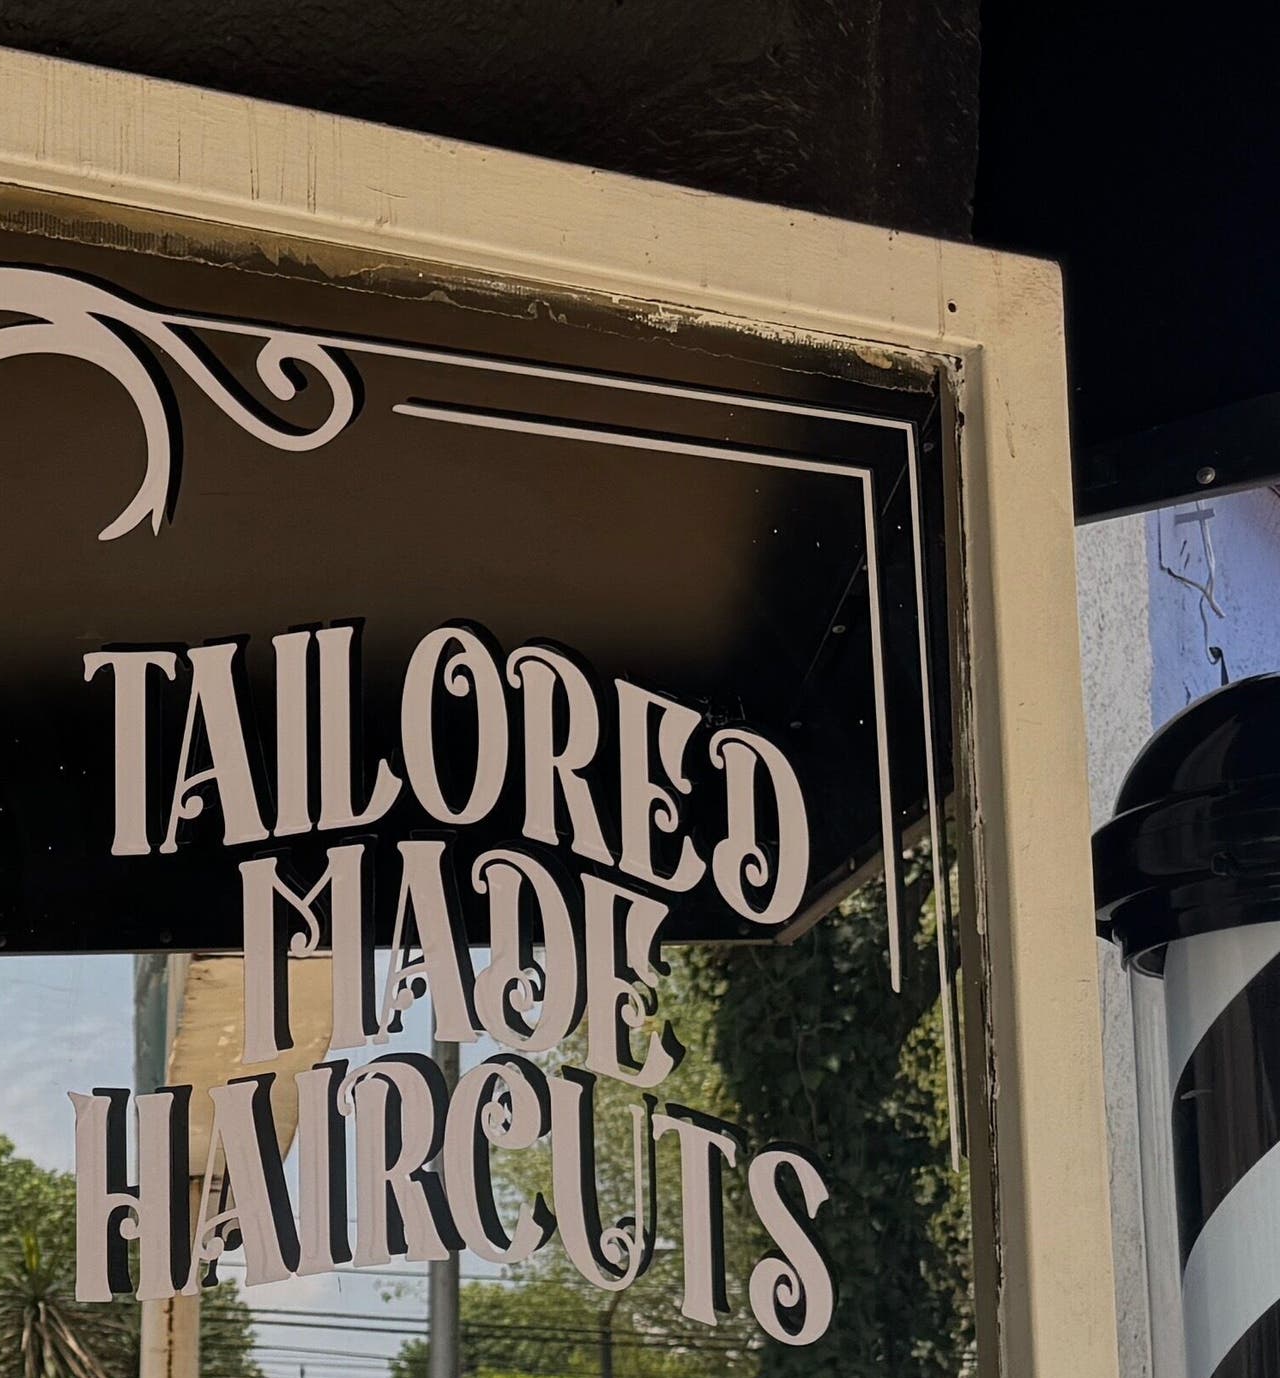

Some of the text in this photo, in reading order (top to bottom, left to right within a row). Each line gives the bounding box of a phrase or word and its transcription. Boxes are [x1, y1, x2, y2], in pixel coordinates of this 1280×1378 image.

[83, 626, 809, 925] TAILORED
[239, 840, 673, 1088] MADE
[67, 1061, 834, 1346] HAIRCUTS
